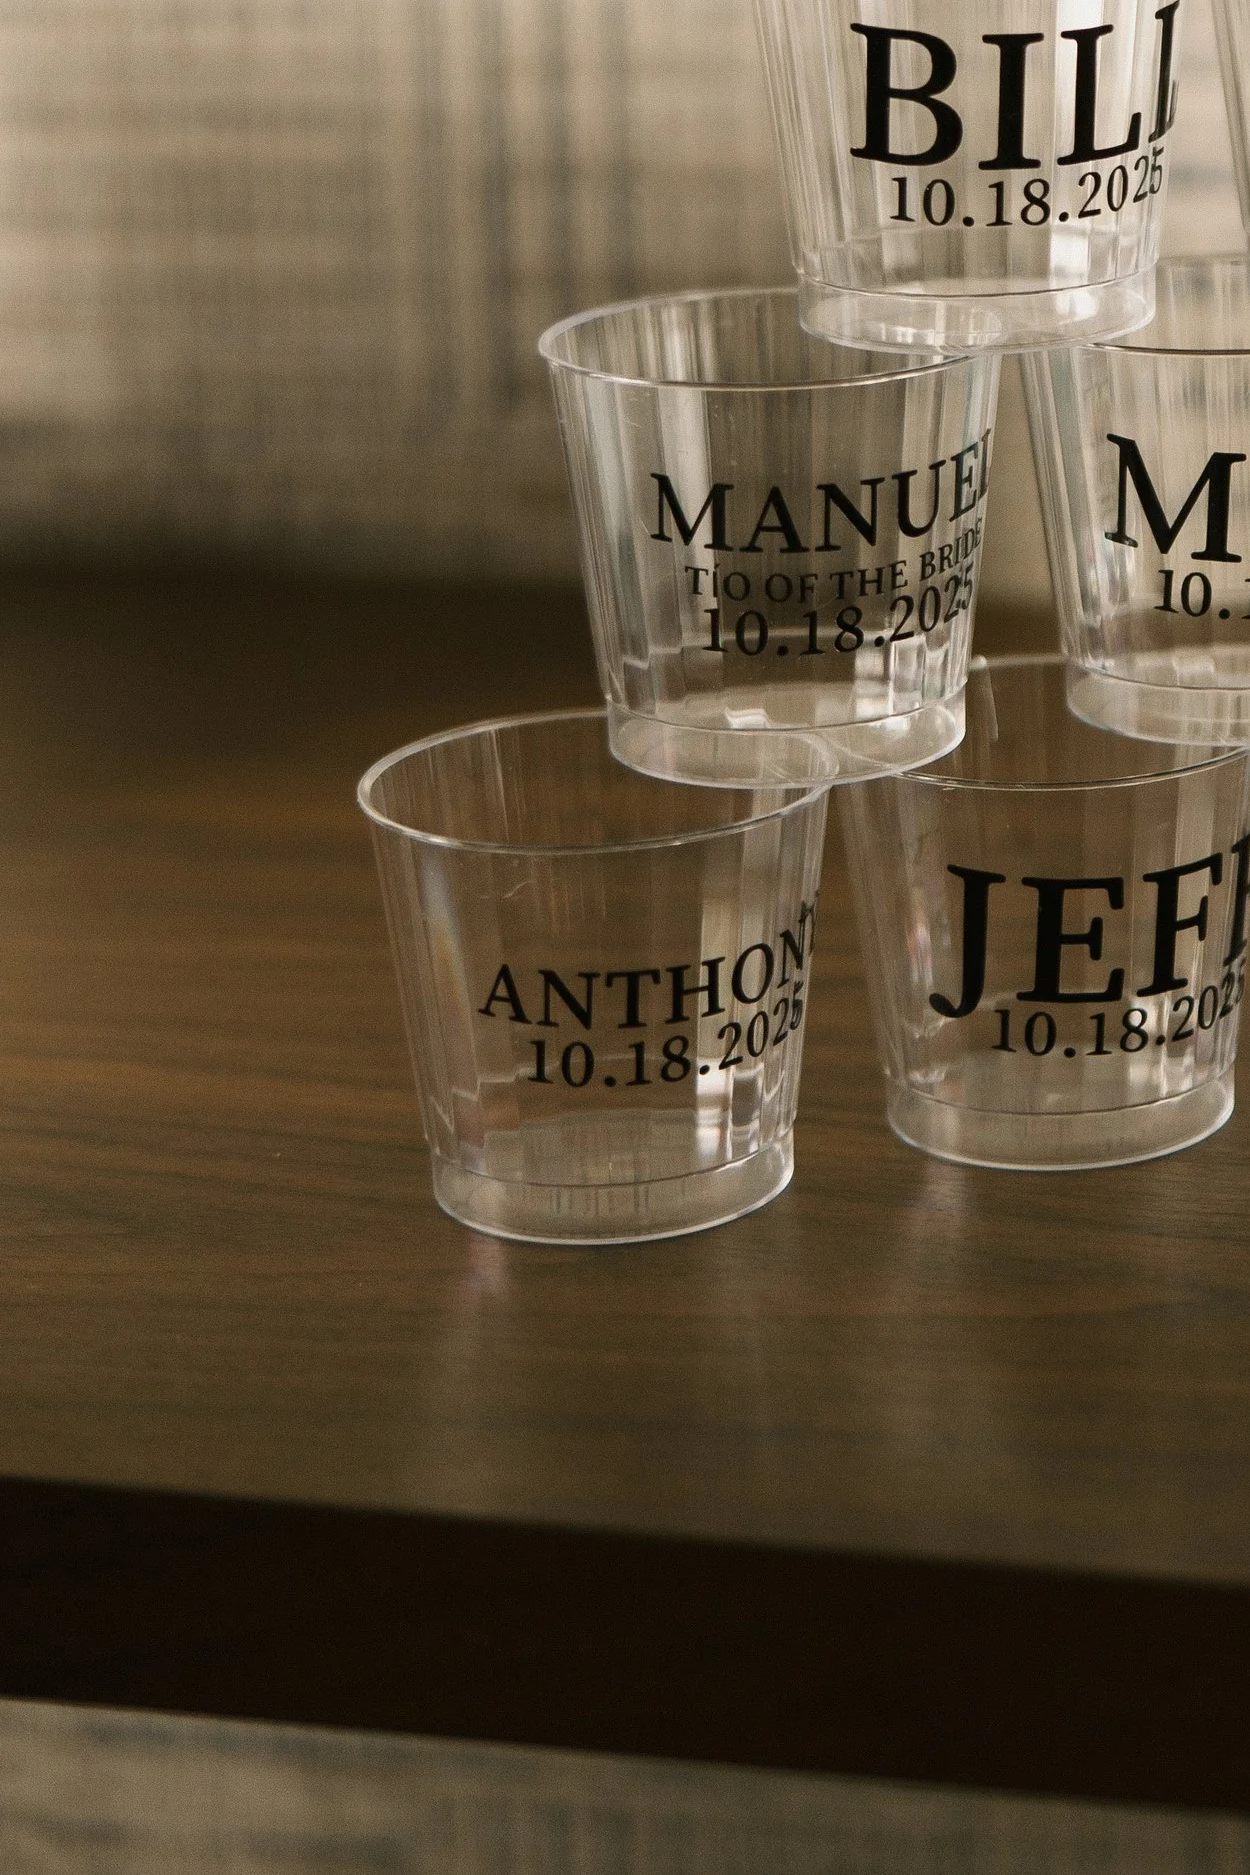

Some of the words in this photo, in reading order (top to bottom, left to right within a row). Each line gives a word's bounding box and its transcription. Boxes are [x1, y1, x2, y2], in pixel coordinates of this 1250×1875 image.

[890, 146, 1165, 227] 10.18.2025
[765, 572, 819, 603] OF
[830, 560, 908, 601] THE
[919, 516, 983, 581] BRIDE
[702, 560, 974, 656] 10.18.2025
